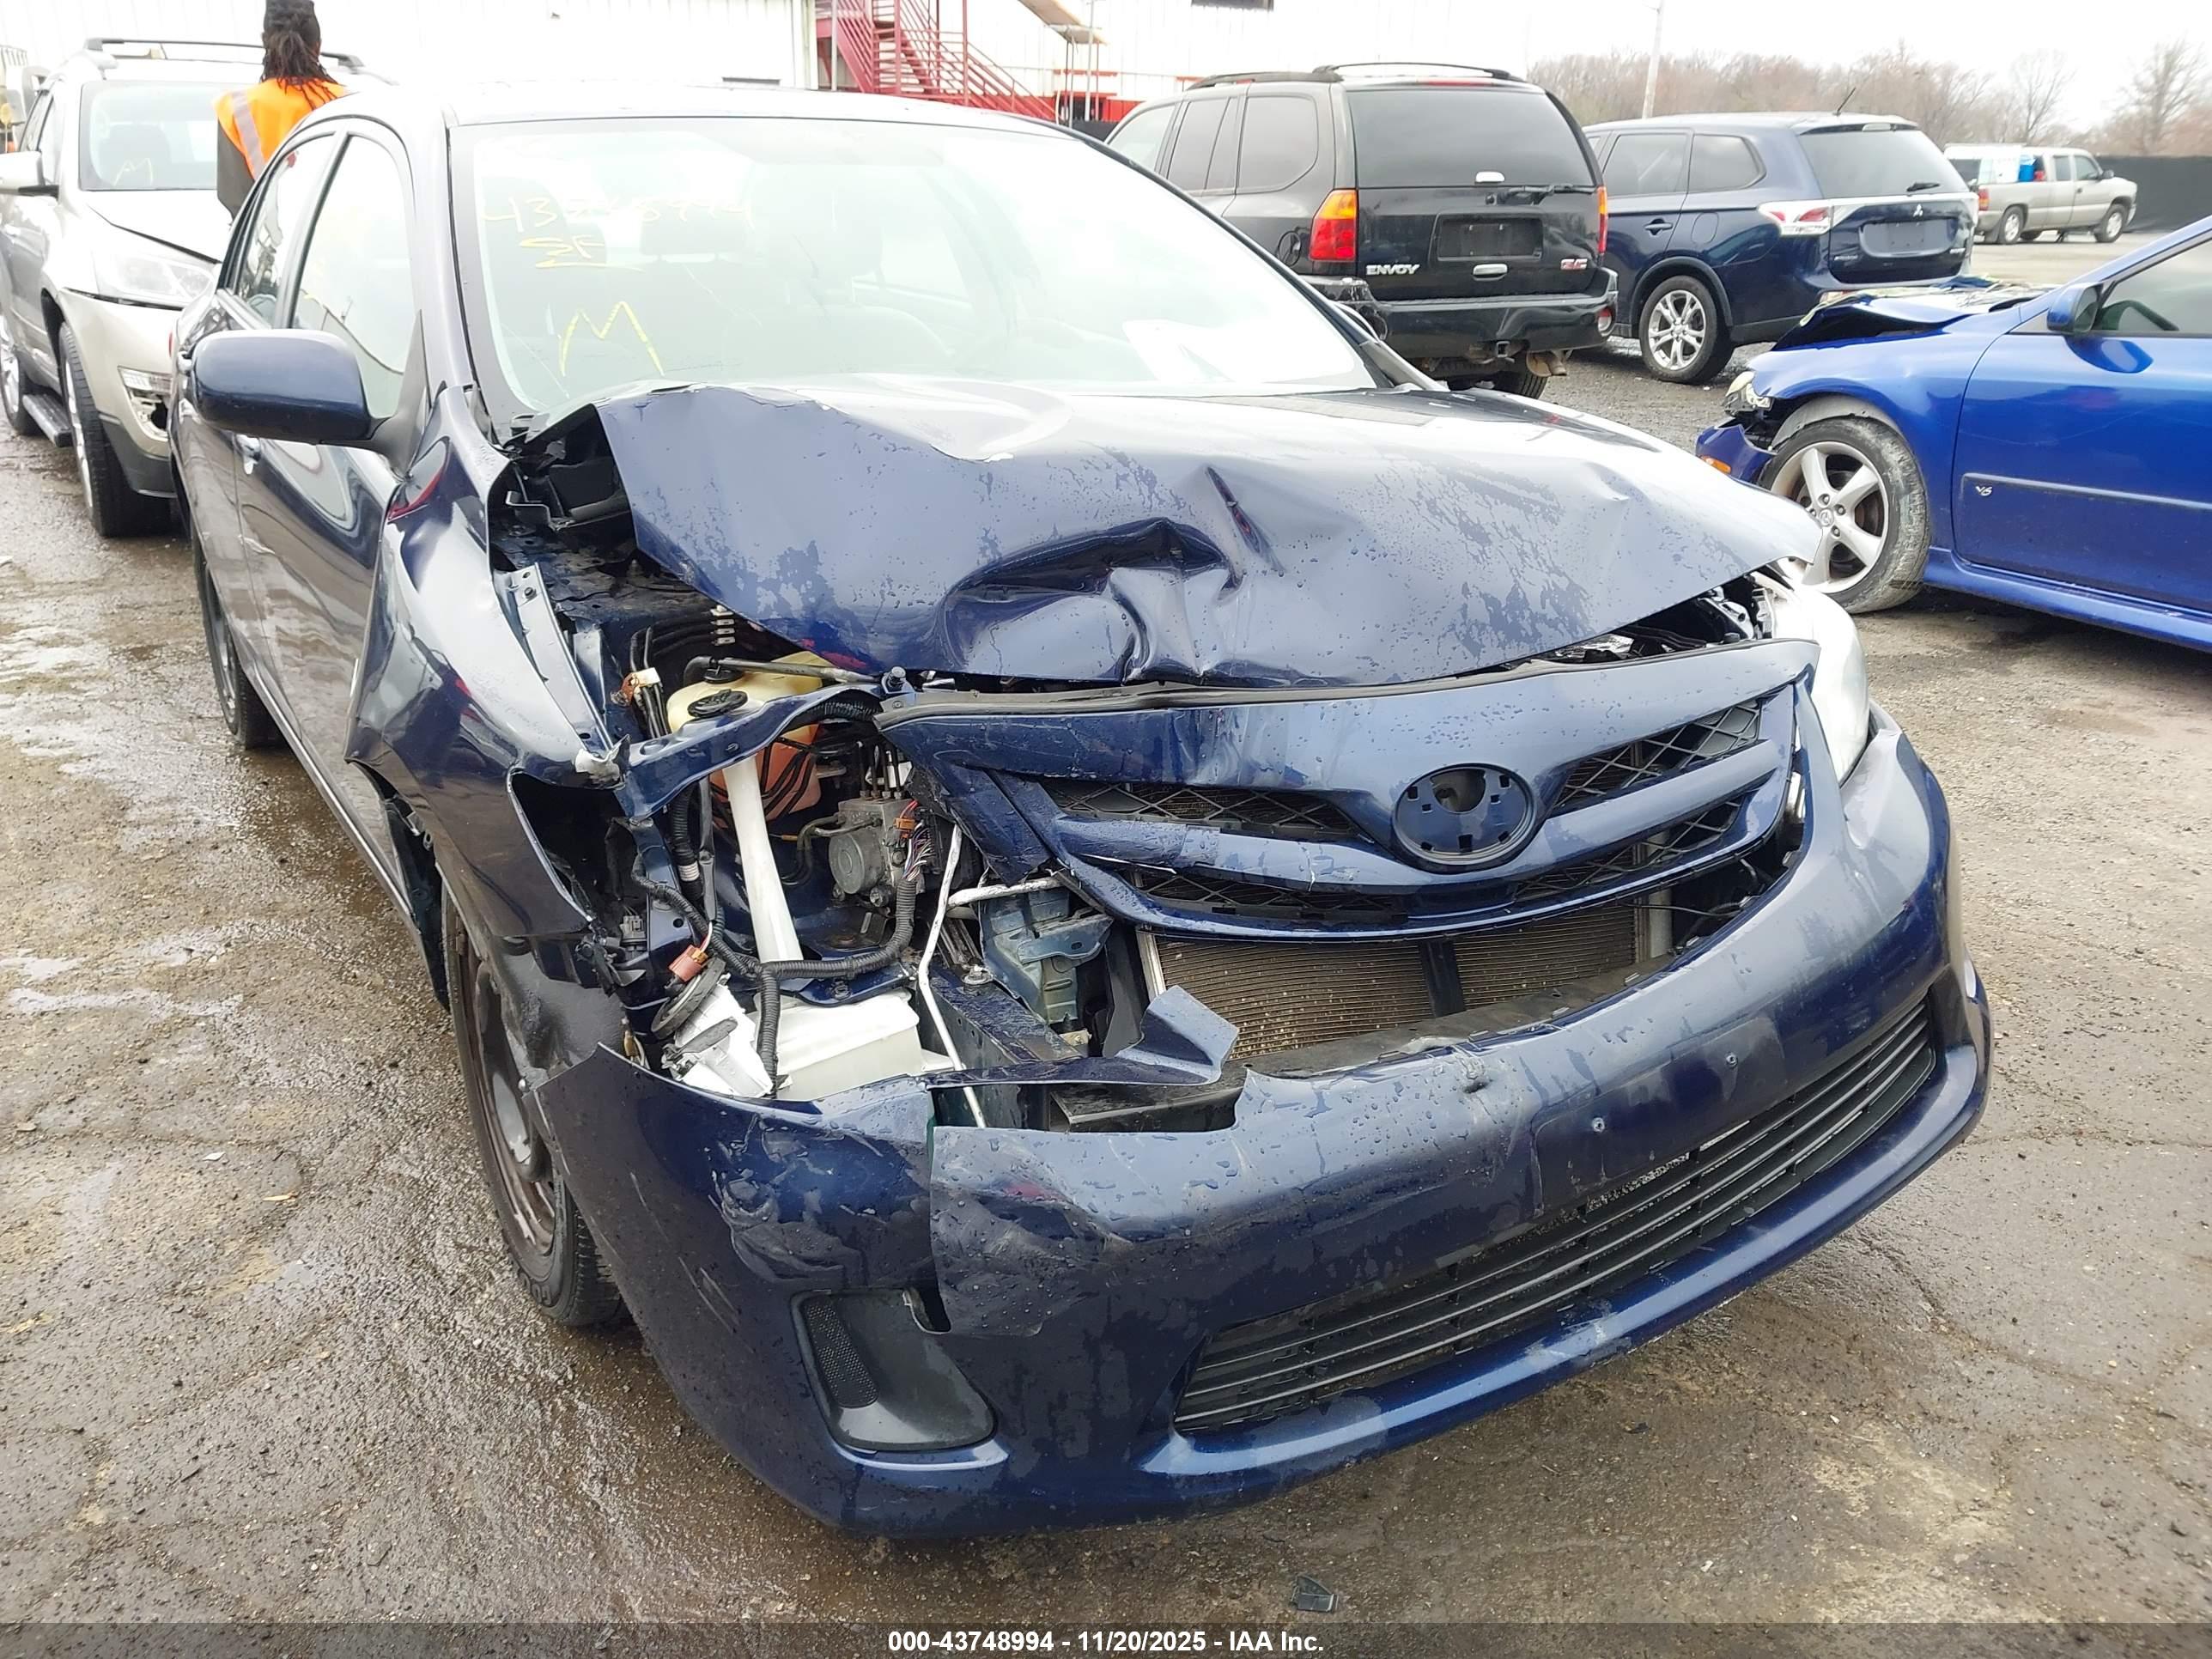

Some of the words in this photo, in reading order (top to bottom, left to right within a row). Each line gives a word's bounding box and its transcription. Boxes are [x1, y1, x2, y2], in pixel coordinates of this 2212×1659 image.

[1365, 264, 1420, 276] ENVOY
[559, 301, 665, 376] M
[1975, 486, 1993, 496] V6
